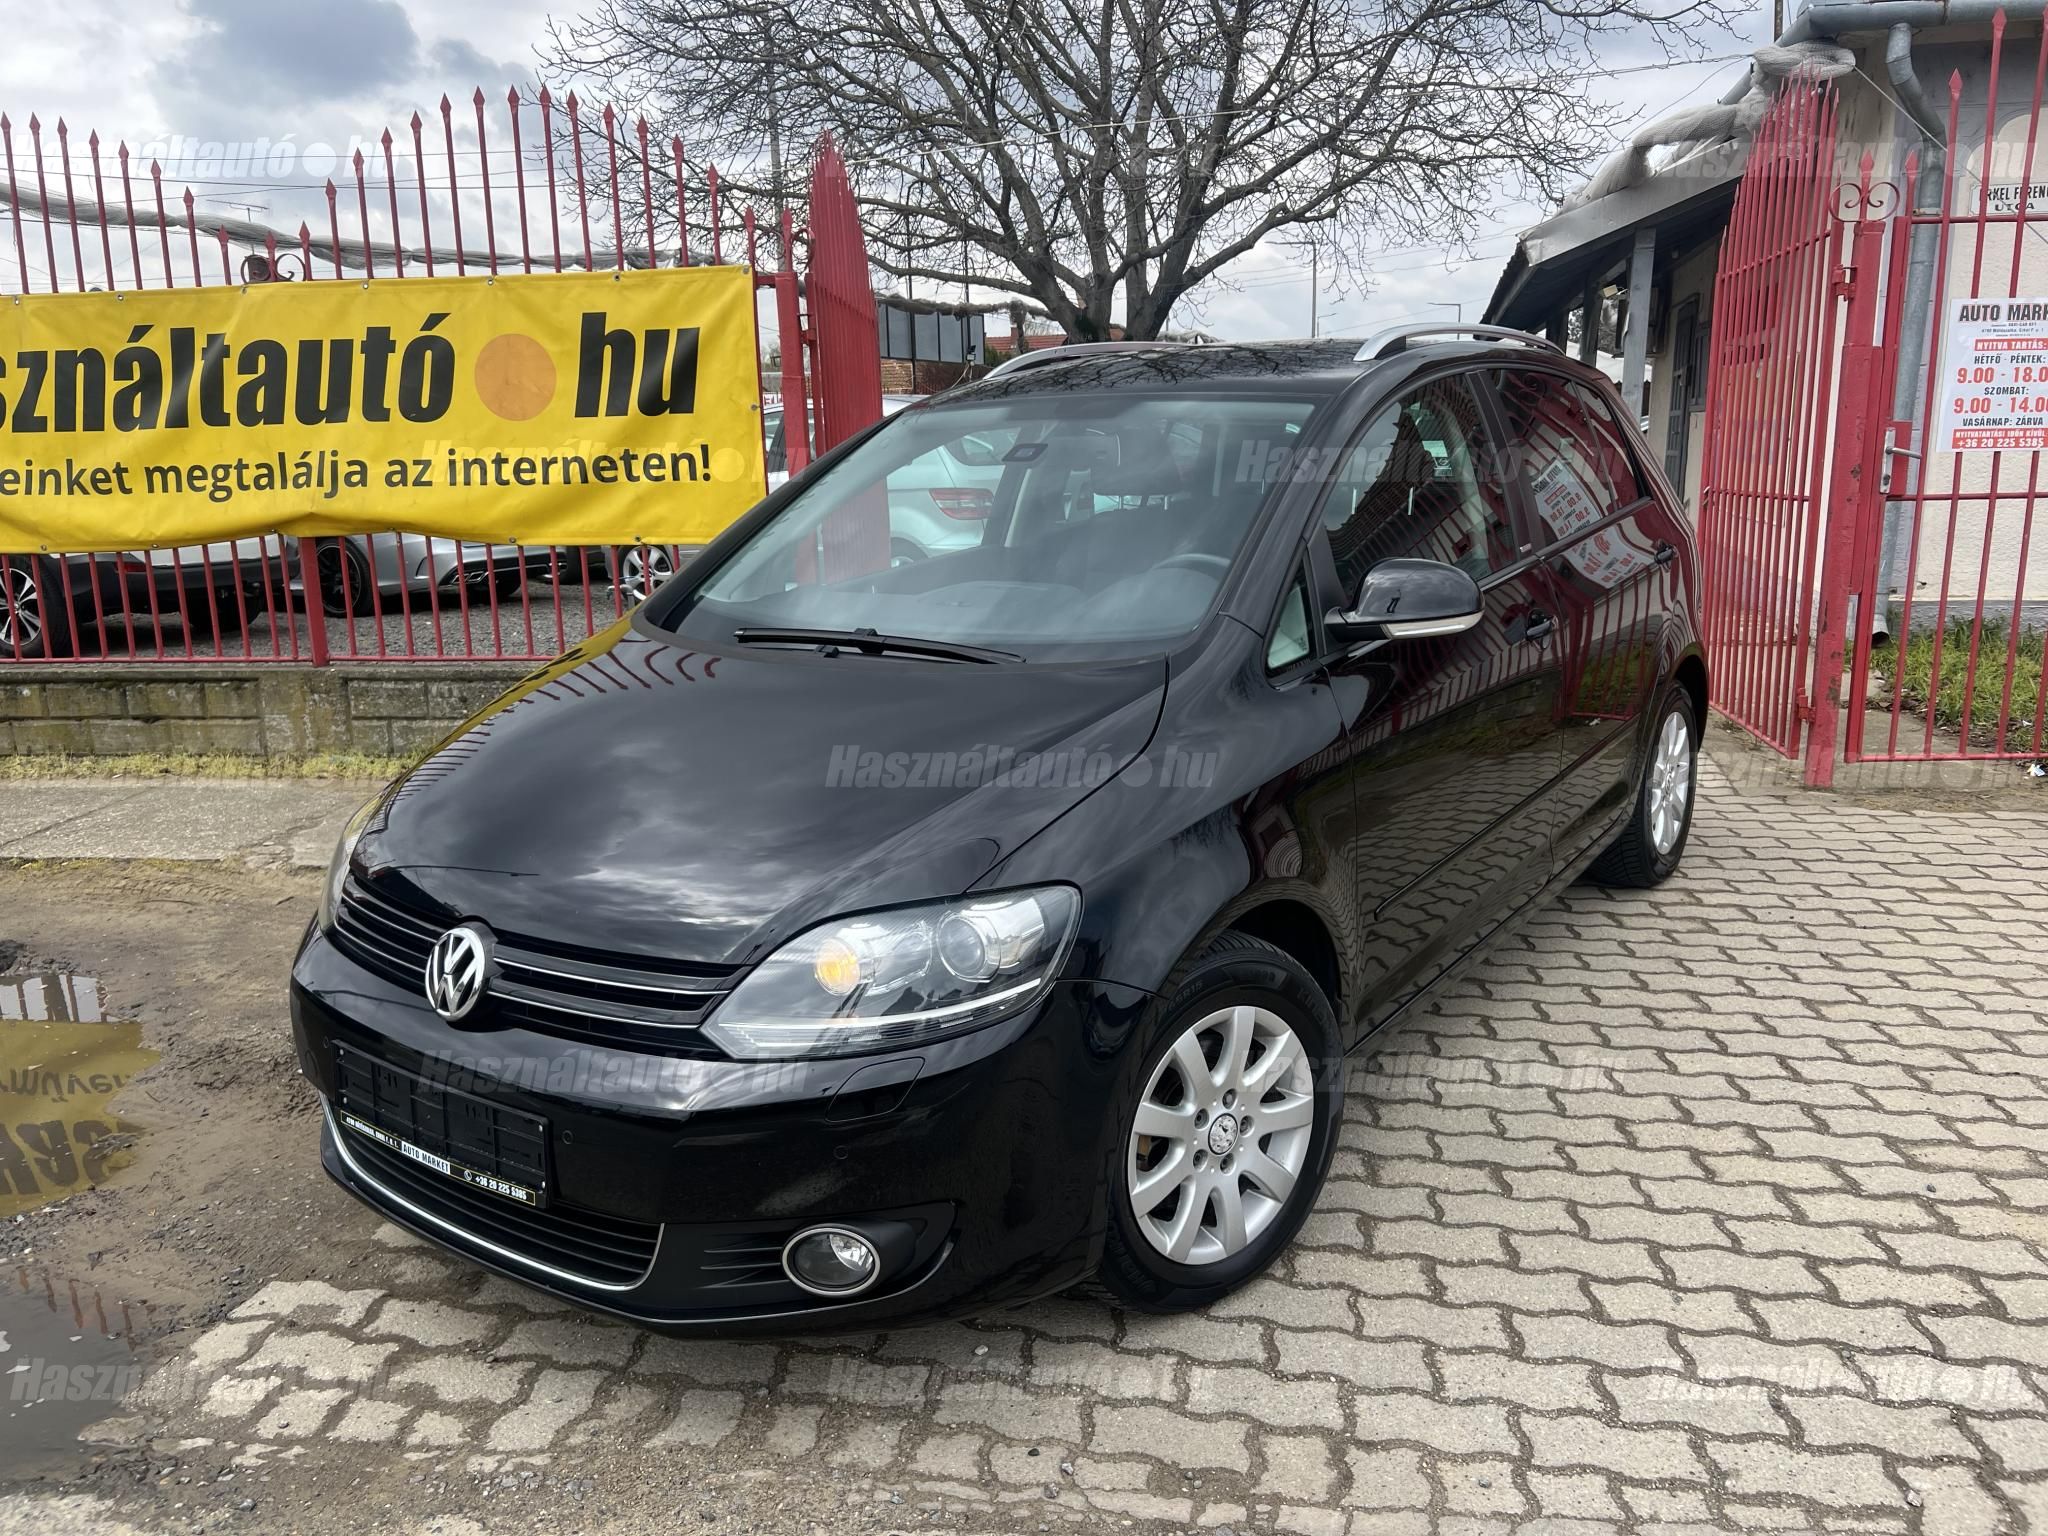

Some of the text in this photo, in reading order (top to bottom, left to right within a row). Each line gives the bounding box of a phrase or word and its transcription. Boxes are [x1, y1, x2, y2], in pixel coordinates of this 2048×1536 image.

[1980, 185, 2048, 200] RKEL FREN
[1960, 305, 2000, 321] AUTO
[1977, 339, 2047, 350] NYITVA TARTÁS:
[1974, 353, 2001, 364] HÉTFŐ
[2010, 353, 2046, 364] PÉNTEK:
[0, 313, 454, 432] ználtautó
[1957, 367, 1995, 383] 9.00
[1984, 386, 2029, 396] SZOMBAT:
[1954, 397, 1991, 413] 9.00
[2010, 396, 2048, 413] 14.0
[1962, 414, 2043, 426] VASÁRNAP: ZÁRVA
[1958, 438, 2044, 448] +36 20 225 5385
[144, 448, 368, 502] megtalálja
[384, 457, 432, 488] az
[448, 443, 711, 487] interneten!
[403, 1144, 420, 1158] AUTO
[421, 1153, 449, 1173] MARKET
